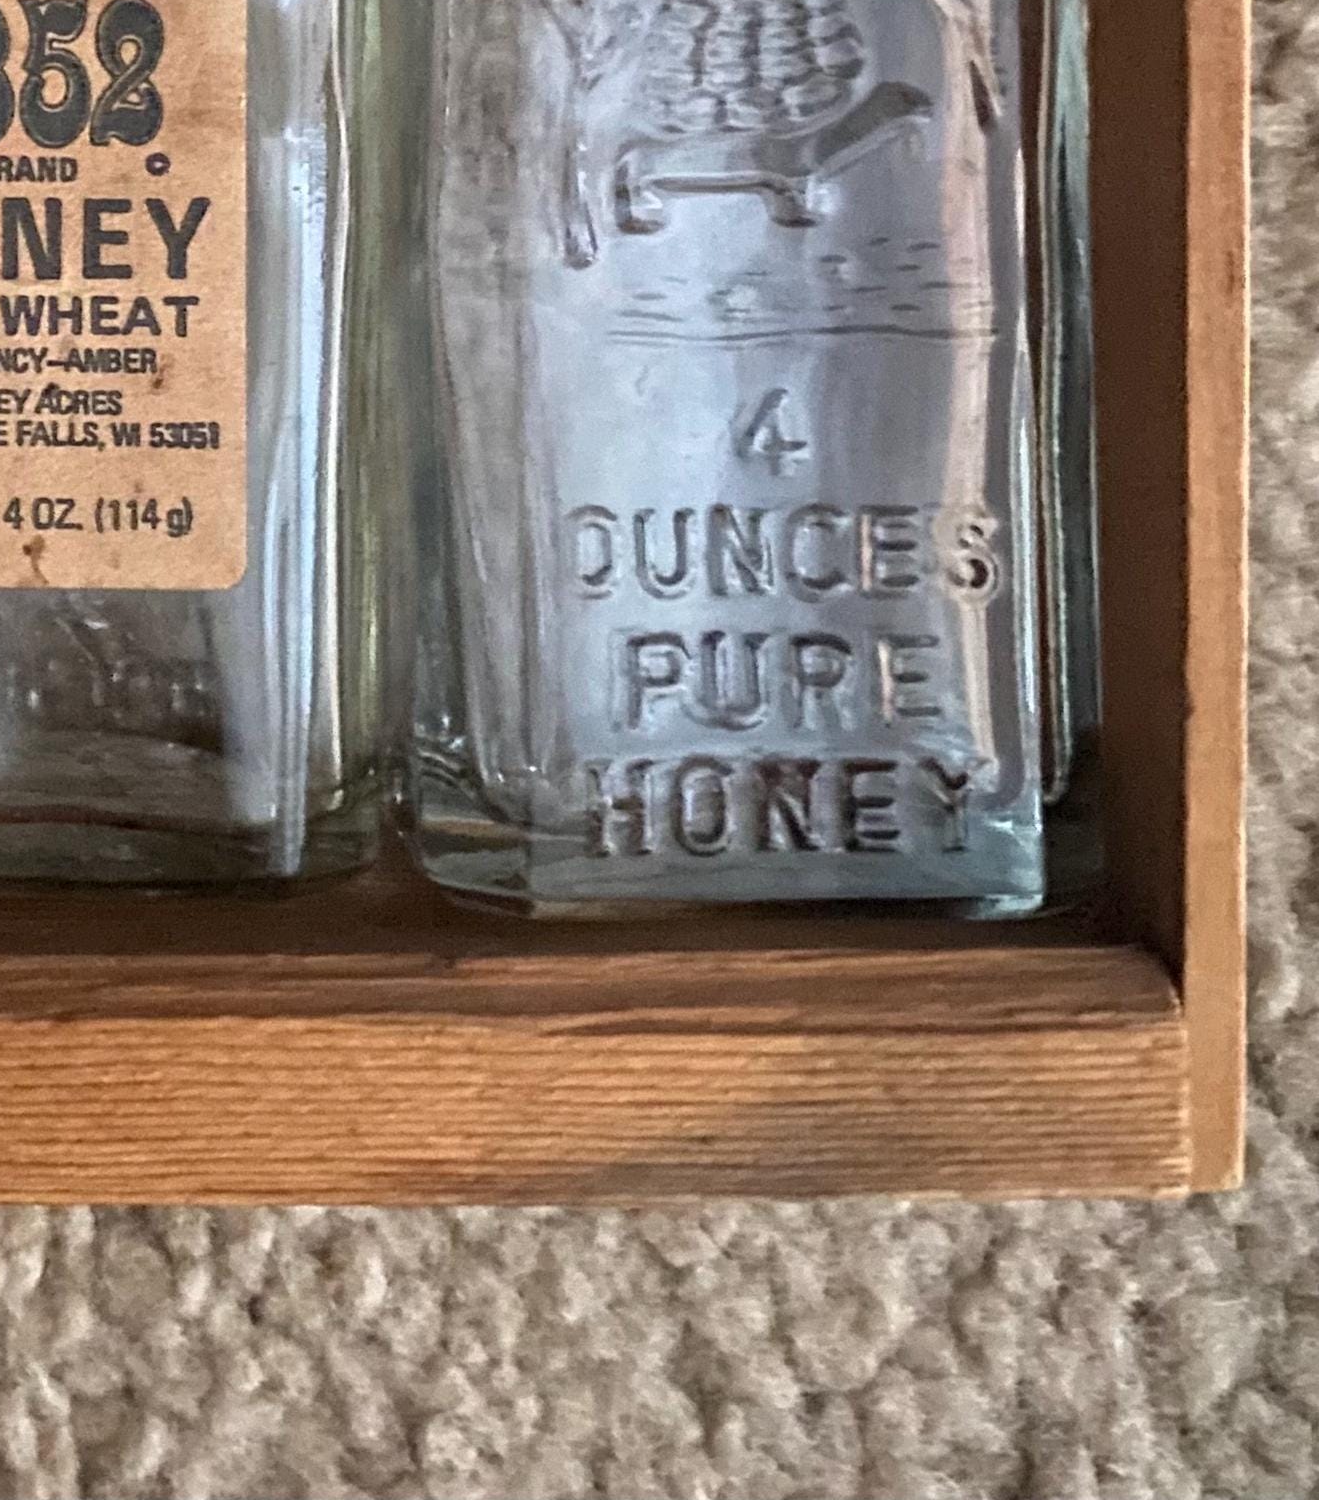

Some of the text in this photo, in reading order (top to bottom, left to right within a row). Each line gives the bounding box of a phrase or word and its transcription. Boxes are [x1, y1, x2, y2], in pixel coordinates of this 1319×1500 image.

[17, 420, 106, 449] FALLS,
[111, 421, 142, 447] WI
[149, 422, 220, 449] 53051
[34, 389, 122, 414] ACRES
[733, 388, 807, 476] 4
[3, 499, 25, 529] 4
[567, 503, 998, 603] OUNCES
[612, 628, 943, 731] PURE
[585, 754, 976, 856] HONEY
